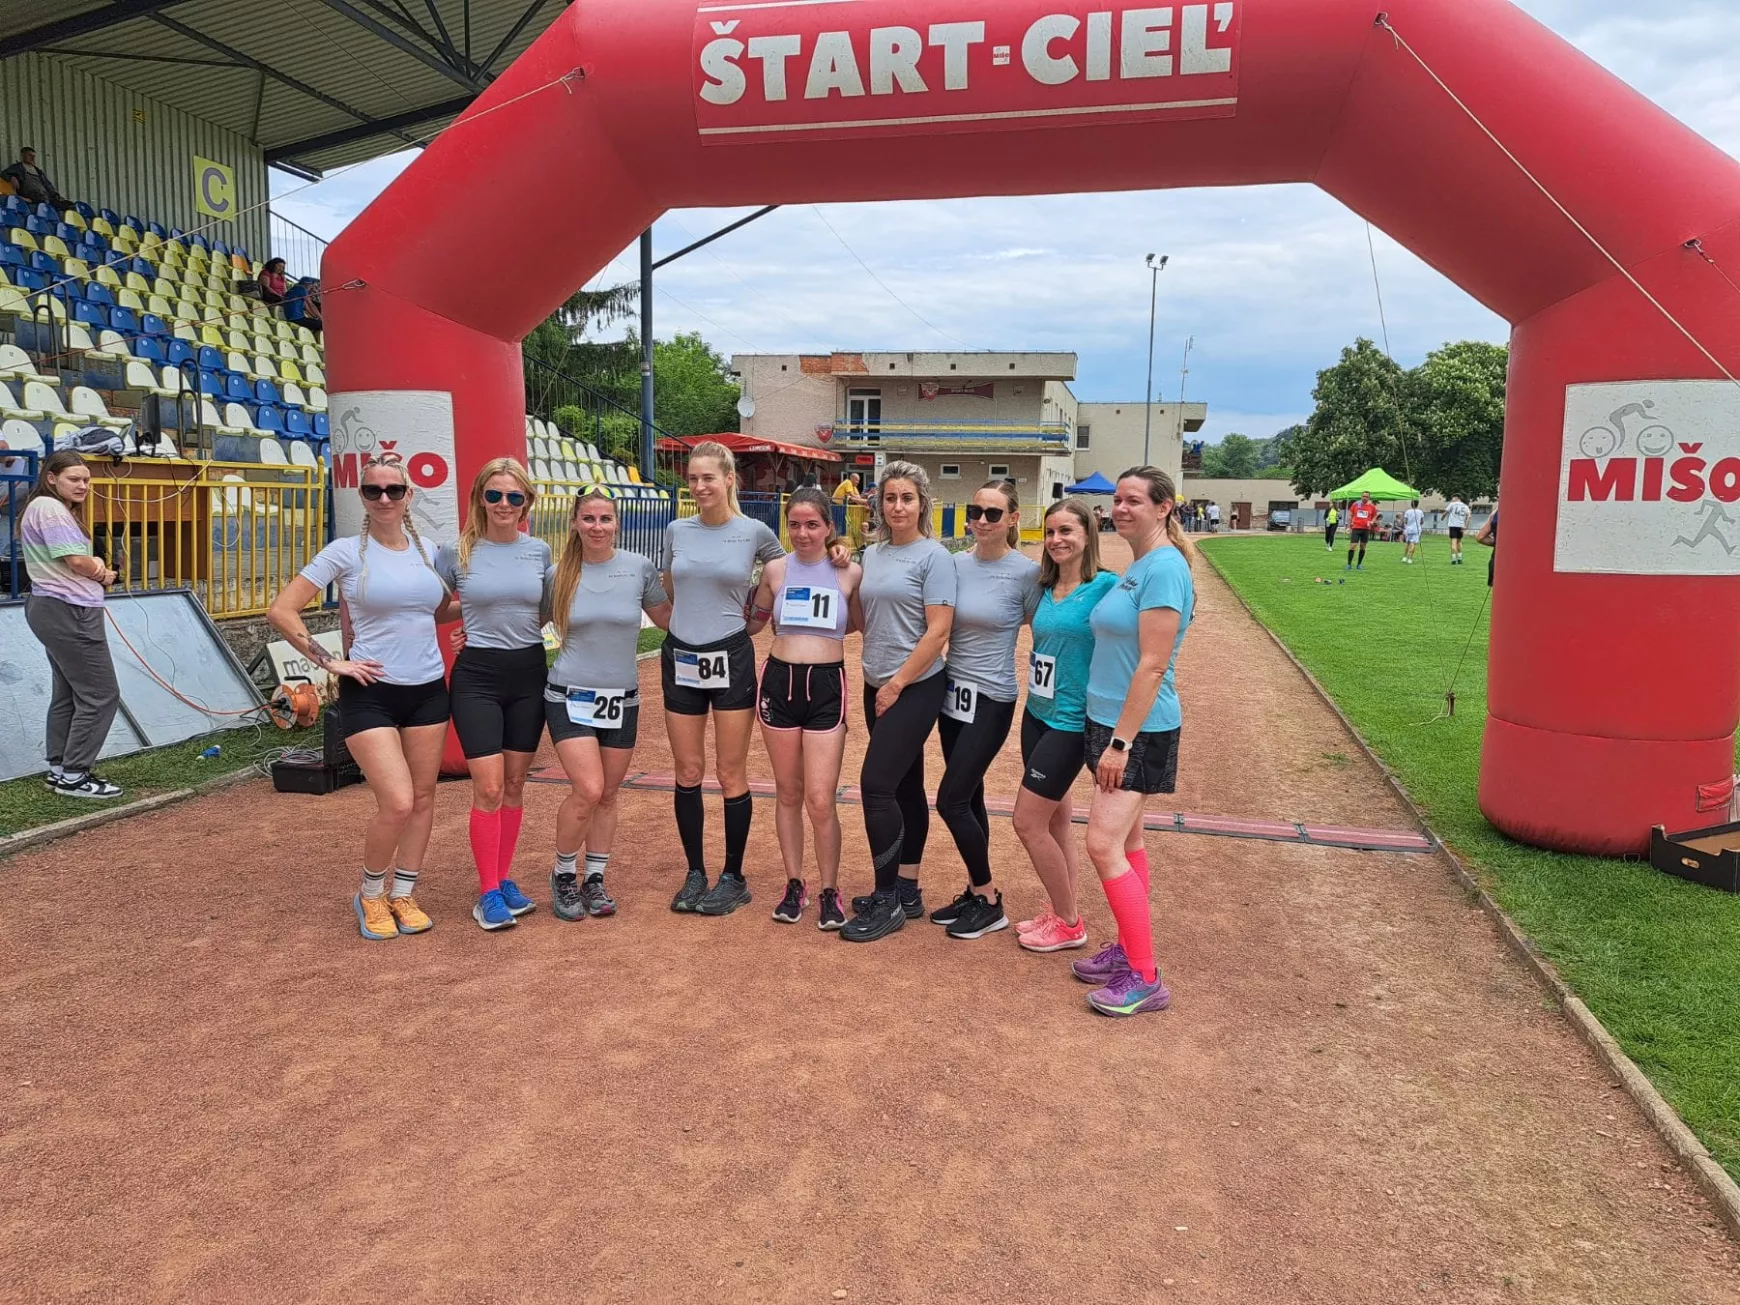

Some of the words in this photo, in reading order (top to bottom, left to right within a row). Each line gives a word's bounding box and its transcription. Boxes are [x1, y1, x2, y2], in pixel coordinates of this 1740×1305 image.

[202, 167, 229, 212] C
[1568, 443, 1740, 503] MIŠO
[812, 593, 830, 618] 11
[698, 655, 725, 680] 84
[1034, 660, 1053, 688] 67
[593, 695, 621, 720] 26
[954, 686, 972, 713] 19
